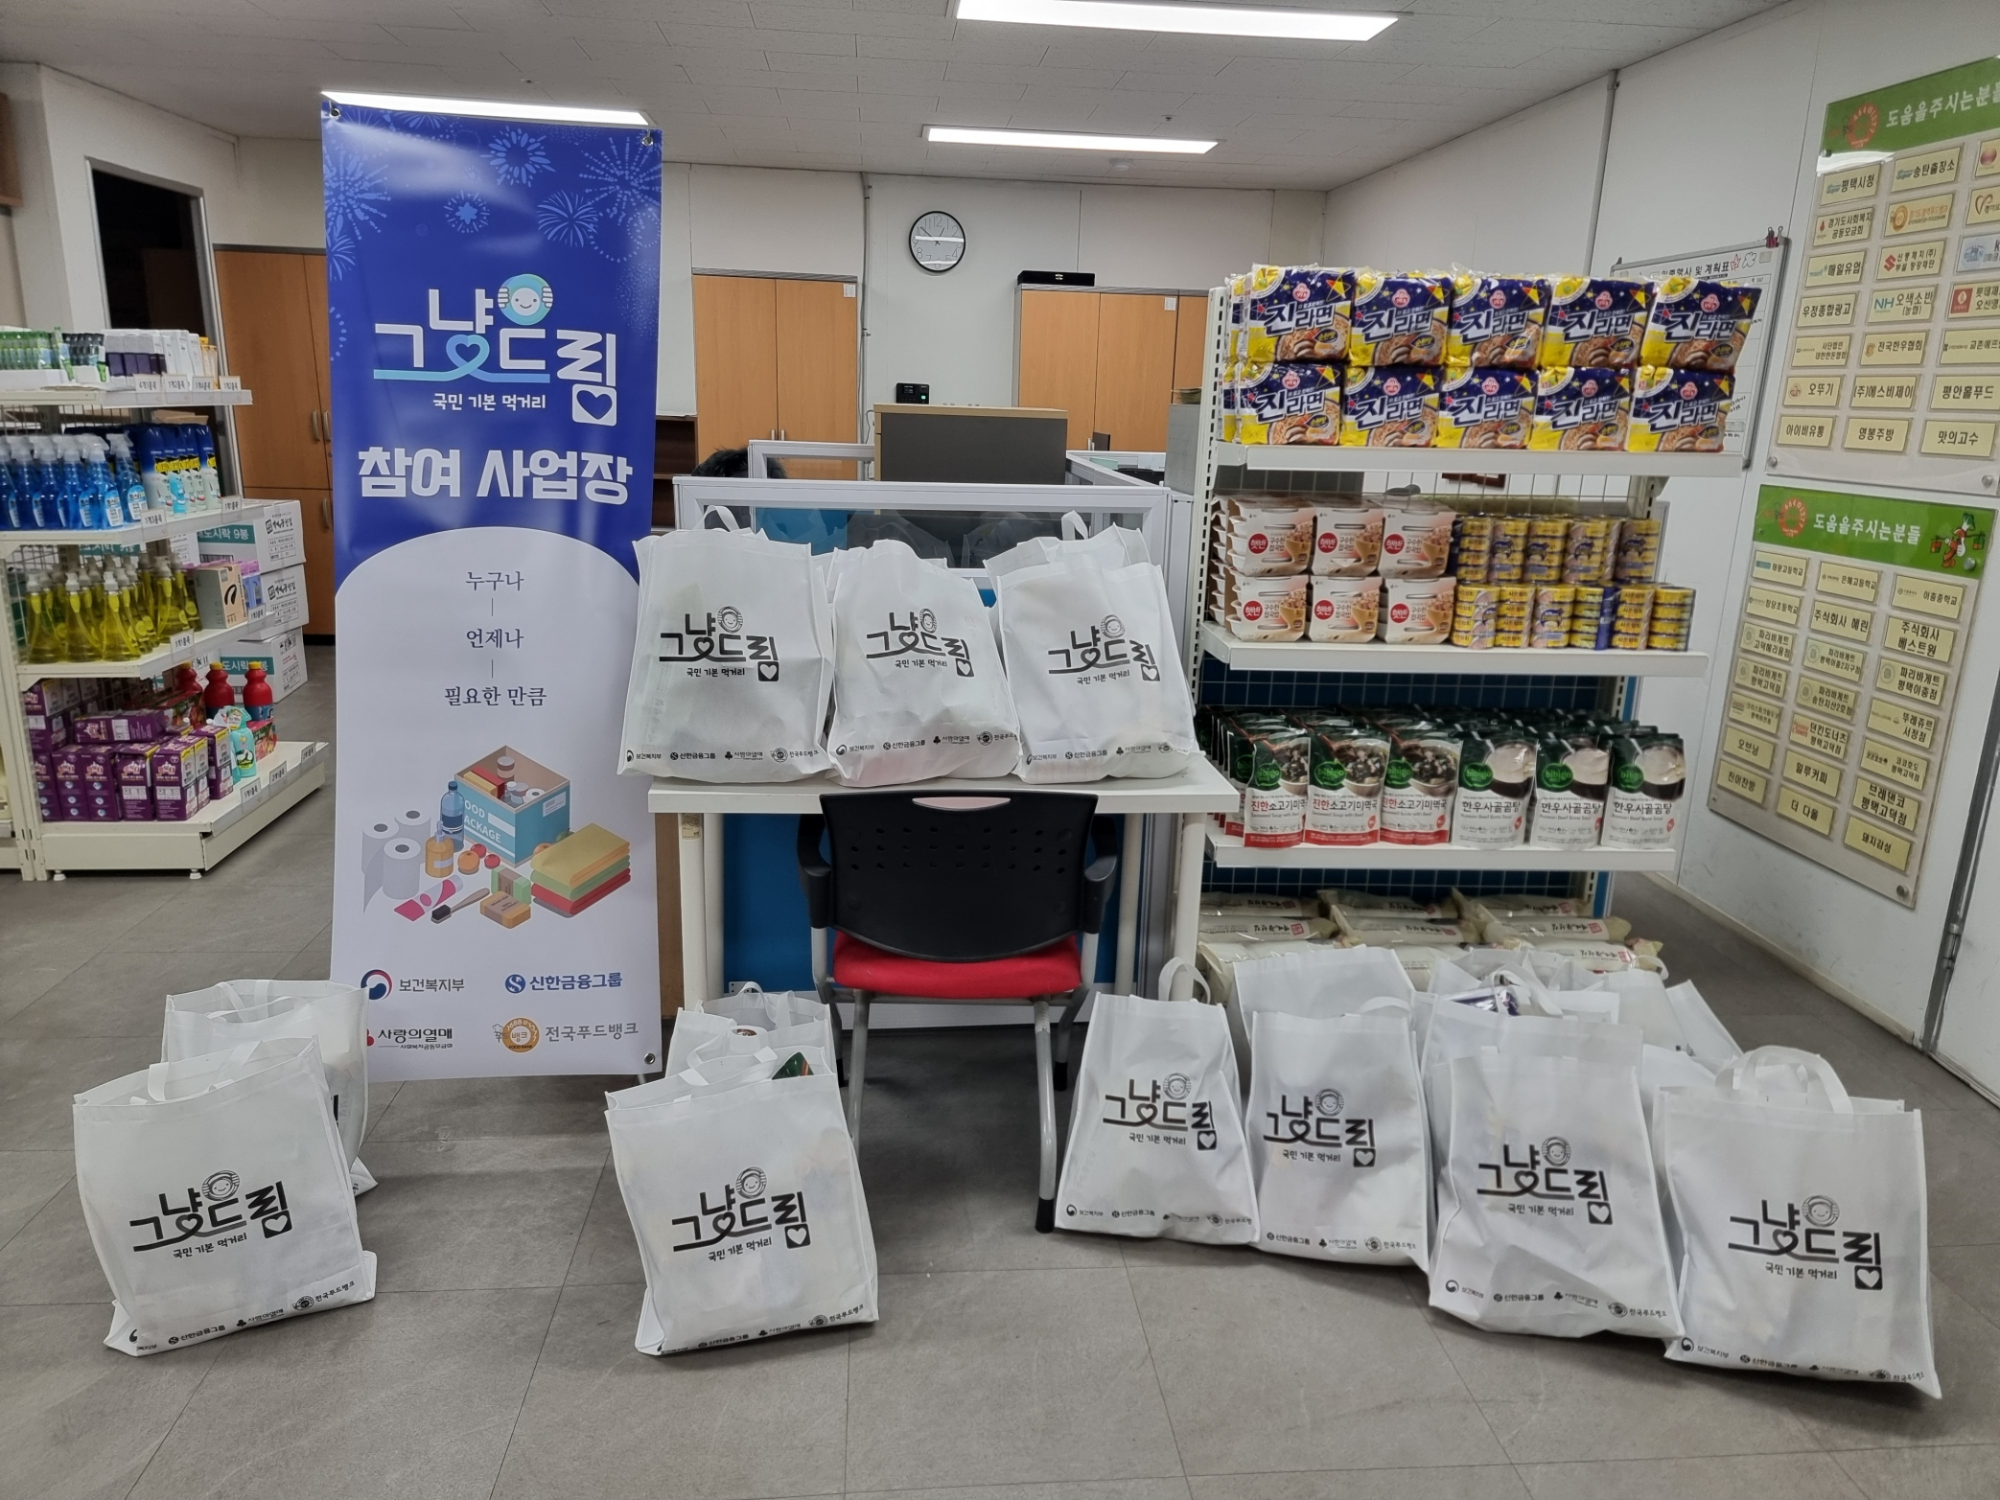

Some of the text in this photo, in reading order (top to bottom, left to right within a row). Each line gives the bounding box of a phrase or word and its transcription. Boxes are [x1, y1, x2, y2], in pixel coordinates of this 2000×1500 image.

[1913, 160, 1955, 179] 송탄출장소
[1841, 174, 1875, 193] 평택시청
[1704, 261, 1730, 274] 계획표
[1828, 261, 1861, 277] 매일유업
[1874, 298, 1894, 309] NH
[1895, 291, 1933, 306] 오색소반
[1263, 301, 1336, 337] 진라면
[1802, 302, 1851, 318] 우정종합광고
[1362, 306, 1434, 343] 진라면
[1461, 309, 1527, 344] 진라면
[1563, 309, 1635, 343] 진라면
[1664, 311, 1738, 343] 진라면
[1877, 340, 1923, 352] 전국한우협회
[1808, 383, 1834, 396] 오뚜기
[1942, 385, 1994, 399] 평안홀푸드
[433, 393, 546, 411] 국민 기본 먹거리
[1256, 389, 1325, 424] 진라면
[1355, 395, 1424, 430] 진라면
[1453, 395, 1521, 430] 진라면
[1551, 399, 1622, 431] 진라면
[1649, 402, 1719, 433] 진라면
[1786, 424, 1825, 438] 아이비유통
[1859, 427, 1894, 441] 영봉주방
[1937, 431, 1979, 446] 맛의고수
[358, 446, 633, 505] 참여 사업장
[234, 529, 249, 540] 9봉
[1813, 513, 1921, 545] 도움을주시는분들
[1251, 539, 1267, 549] 햇반
[1320, 538, 1337, 548] 햇반
[1386, 539, 1403, 549] 햇반
[465, 570, 525, 592] 누구나
[1245, 605, 1261, 616] 햇반
[1316, 604, 1333, 615] 햇반
[1392, 608, 1409, 618] 햇반
[1814, 609, 1848, 627] 주식회사
[465, 628, 525, 650] 언제나
[1901, 621, 1940, 642] 주식회사
[1898, 637, 1938, 658] 베스트원
[686, 667, 746, 678] 국민 기본 먹거리
[895, 658, 949, 669] 국민 기본 먹거리
[1076, 670, 1131, 686] 국민 기본 먹거리
[1900, 667, 1940, 687] 파리바게트
[444, 686, 548, 707] 필요한 만큼
[1897, 679, 1938, 700] 평택이충점
[1902, 712, 1933, 731] 뚜레쥬르
[1810, 722, 1847, 744] 던킨도너츠
[1903, 726, 1927, 743] 서정점
[1318, 768, 1344, 778] bibigo
[1896, 757, 1919, 771] 코코호도
[1466, 769, 1492, 779] bibigo
[1545, 770, 1572, 780] bibigo
[1796, 762, 1828, 785] 일루커피
[1869, 784, 1906, 806] 브레댄코
[464, 799, 486, 818] OOD
[1462, 801, 1521, 813] 한우사골곰탕
[1541, 802, 1601, 814] 한우사골곰탕
[1614, 802, 1672, 814] 한우사골곰탕
[1790, 799, 1800, 811] 더
[1861, 796, 1908, 826] 평택고덕점
[464, 815, 502, 843] ACKAGE
[1861, 831, 1892, 854] 돼지감성
[399, 977, 465, 992] 보건복지부
[529, 972, 623, 991] 신한금융그룹
[378, 1028, 454, 1043] 사랑의열매
[545, 1022, 639, 1042] 전국푸드뱅크
[1129, 1132, 1187, 1146] 국민 기본 먹거리
[1282, 1149, 1342, 1163] 국민 기본 먹거리
[1507, 1202, 1575, 1217] 국민 기본 먹거리
[173, 1232, 248, 1259] 국민 기본 먹거리
[708, 1236, 773, 1262] 국민 기본 먹거리
[1764, 1261, 1838, 1281] 국민 기본 먹거리
